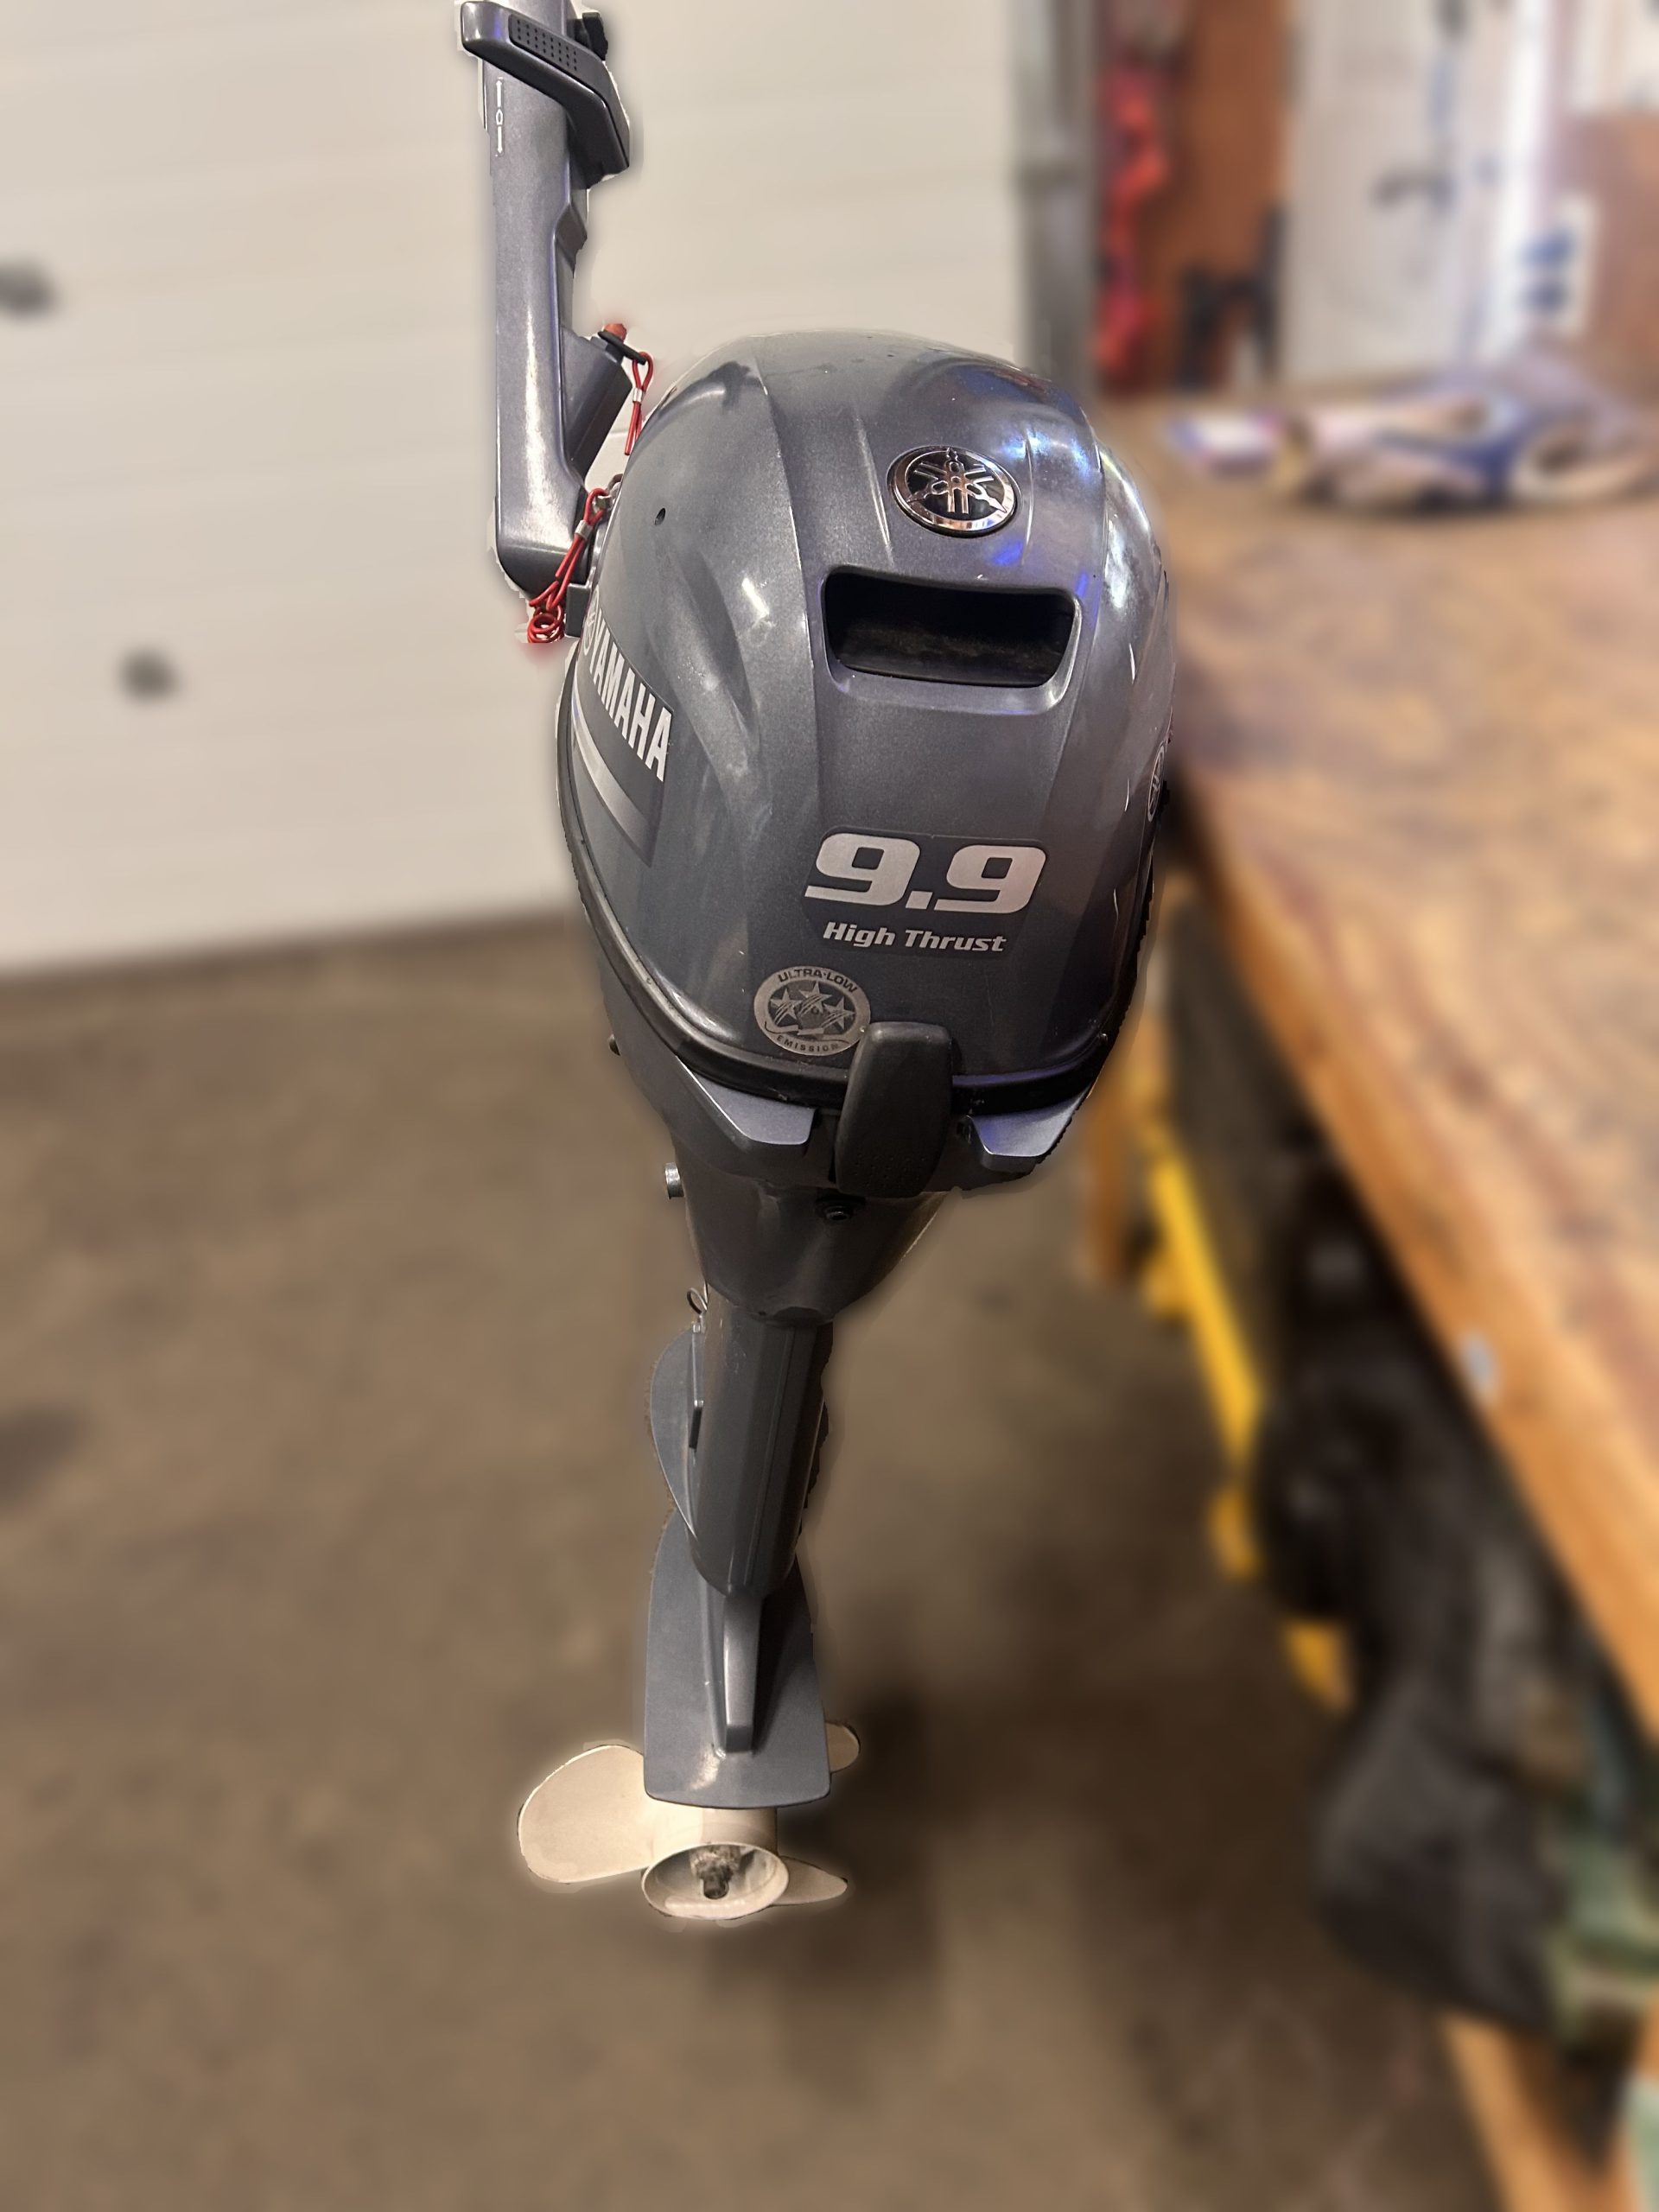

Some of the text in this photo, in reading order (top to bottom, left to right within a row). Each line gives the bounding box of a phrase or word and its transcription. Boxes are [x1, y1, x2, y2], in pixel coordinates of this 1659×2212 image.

[590, 607, 672, 783] YAMAHA
[804, 833, 1046, 914] 9.9
[823, 921, 1007, 952] High Thrust
[776, 1034, 839, 1052] EMISSION
